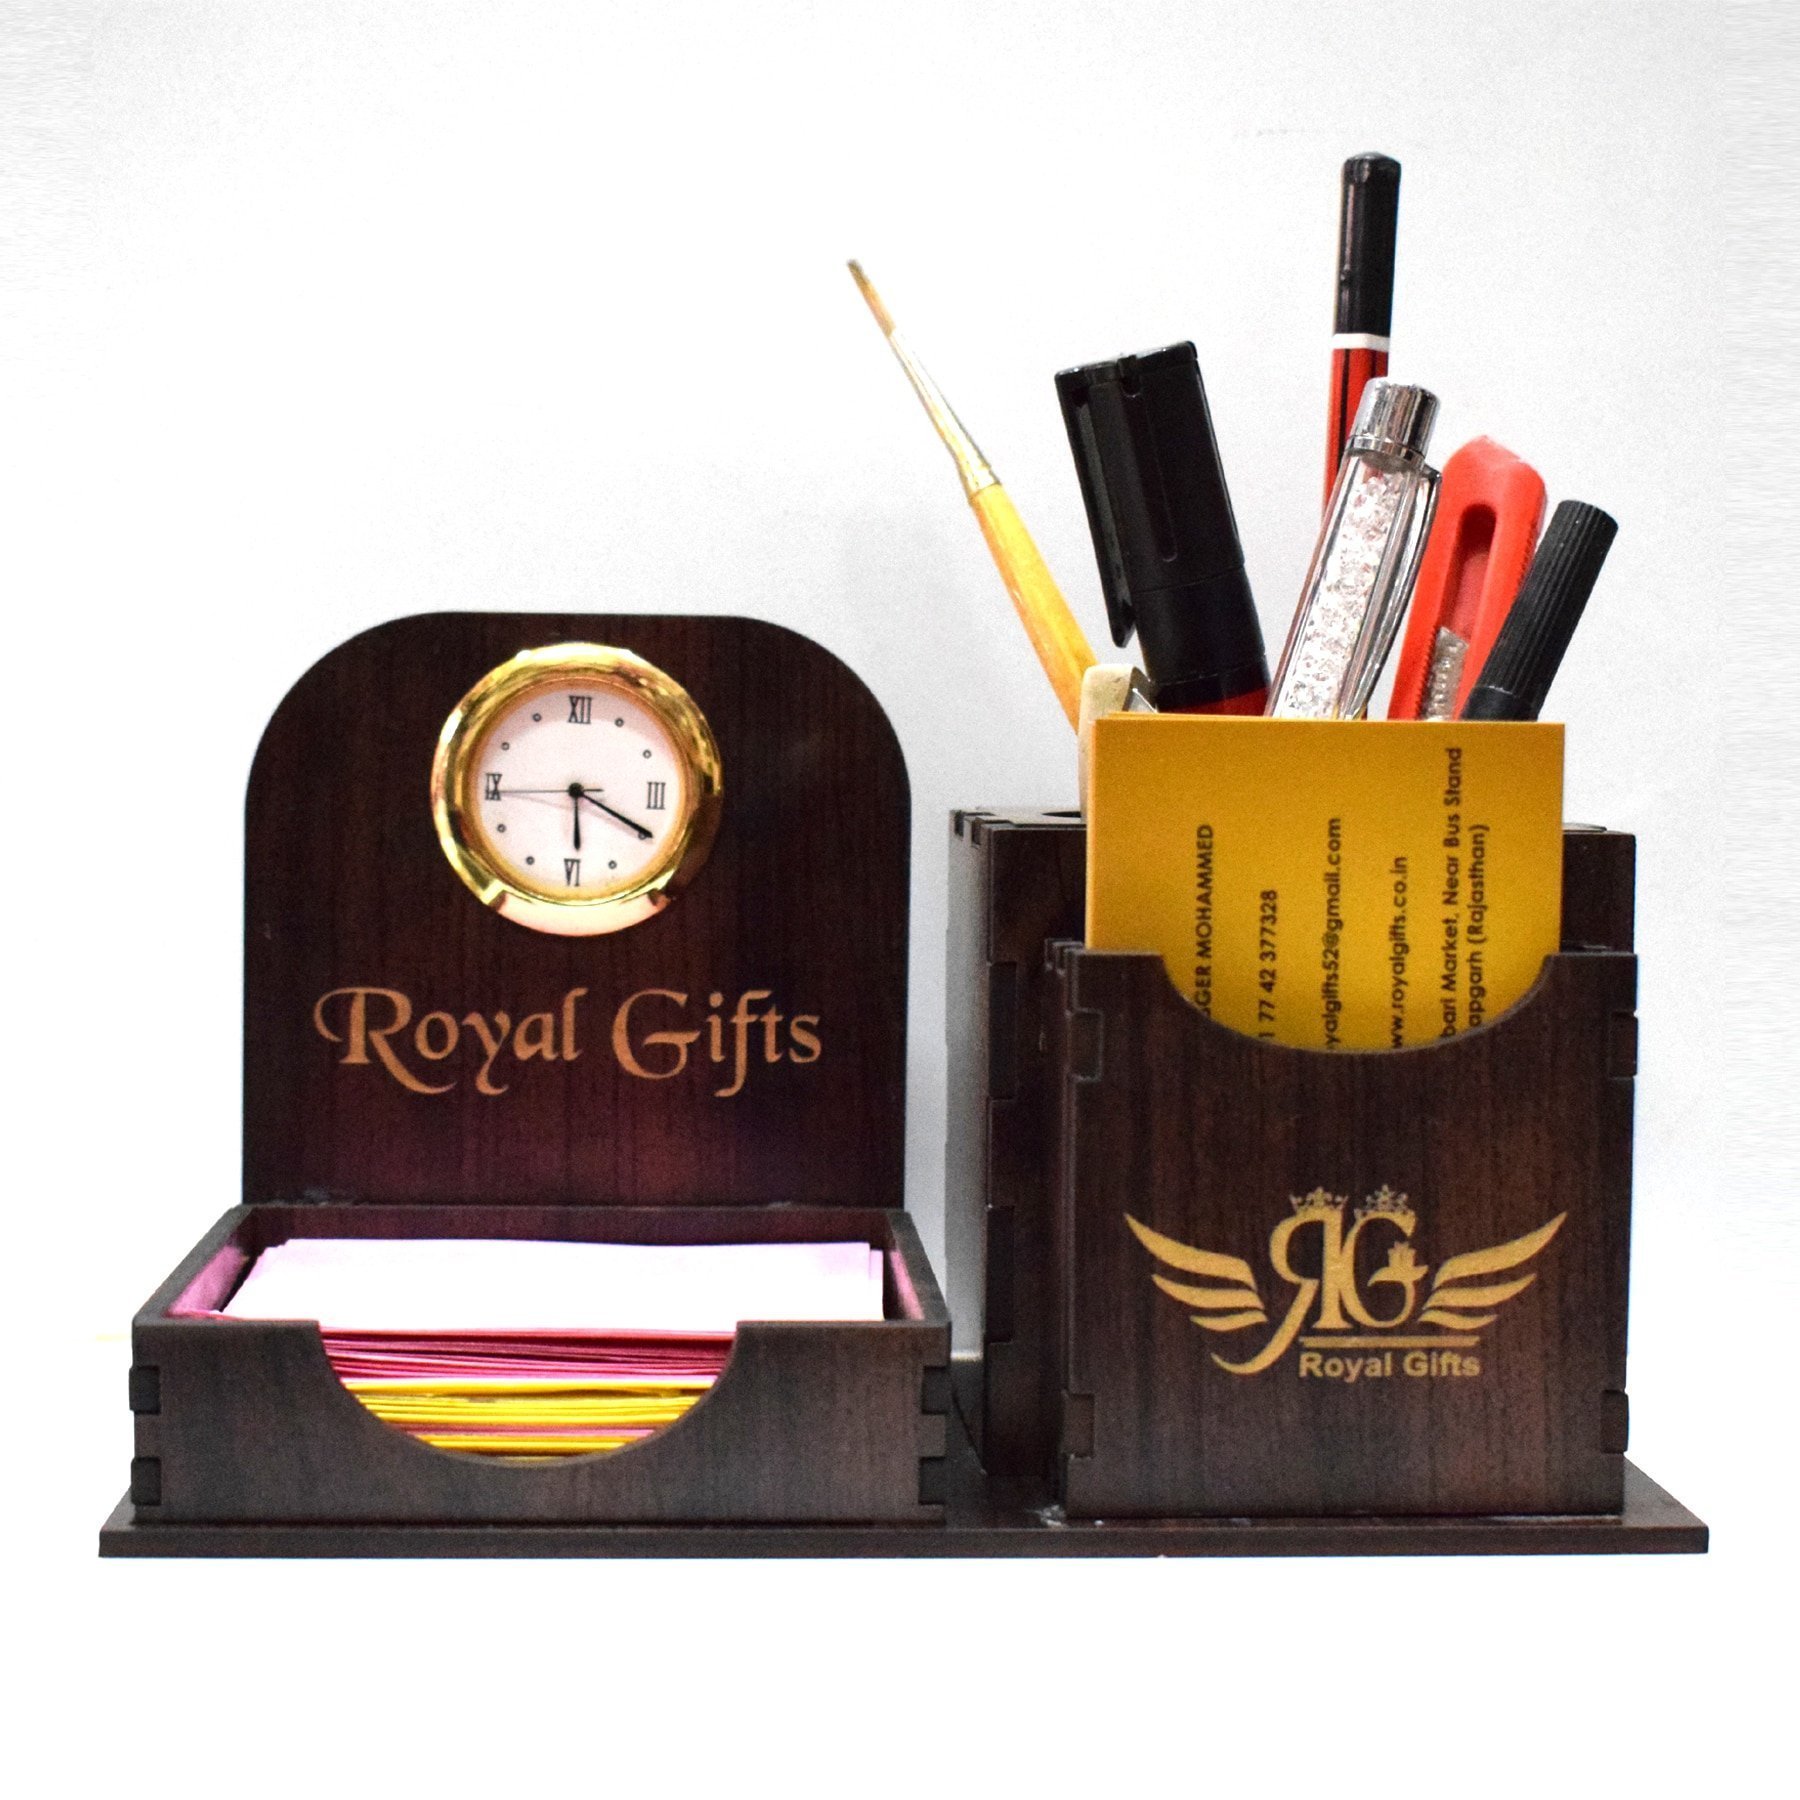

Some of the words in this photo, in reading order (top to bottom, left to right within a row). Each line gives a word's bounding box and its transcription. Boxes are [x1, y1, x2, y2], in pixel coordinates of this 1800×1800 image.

[567, 695, 593, 725] XII
[485, 772, 503, 801] IX
[646, 782, 666, 810] III
[1443, 747, 1463, 807] Stand
[1443, 813, 1461, 848] Bus
[563, 858, 581, 887] VI
[1195, 824, 1214, 959] MOHAMMED
[1442, 855, 1460, 906] Near
[1466, 824, 1491, 944] (Rajasthan)
[1259, 889, 1278, 963] 377328
[1321, 817, 1343, 1050] yalgifts52@gmail.com
[1441, 912, 1460, 992] Market,
[1258, 968, 1277, 994] 42
[1258, 999, 1276, 1022] 77
[313, 986, 590, 1096] Royal
[612, 988, 823, 1098] Gifts
[1299, 1352, 1392, 1383] Royal
[1403, 1351, 1481, 1377] Gifts
